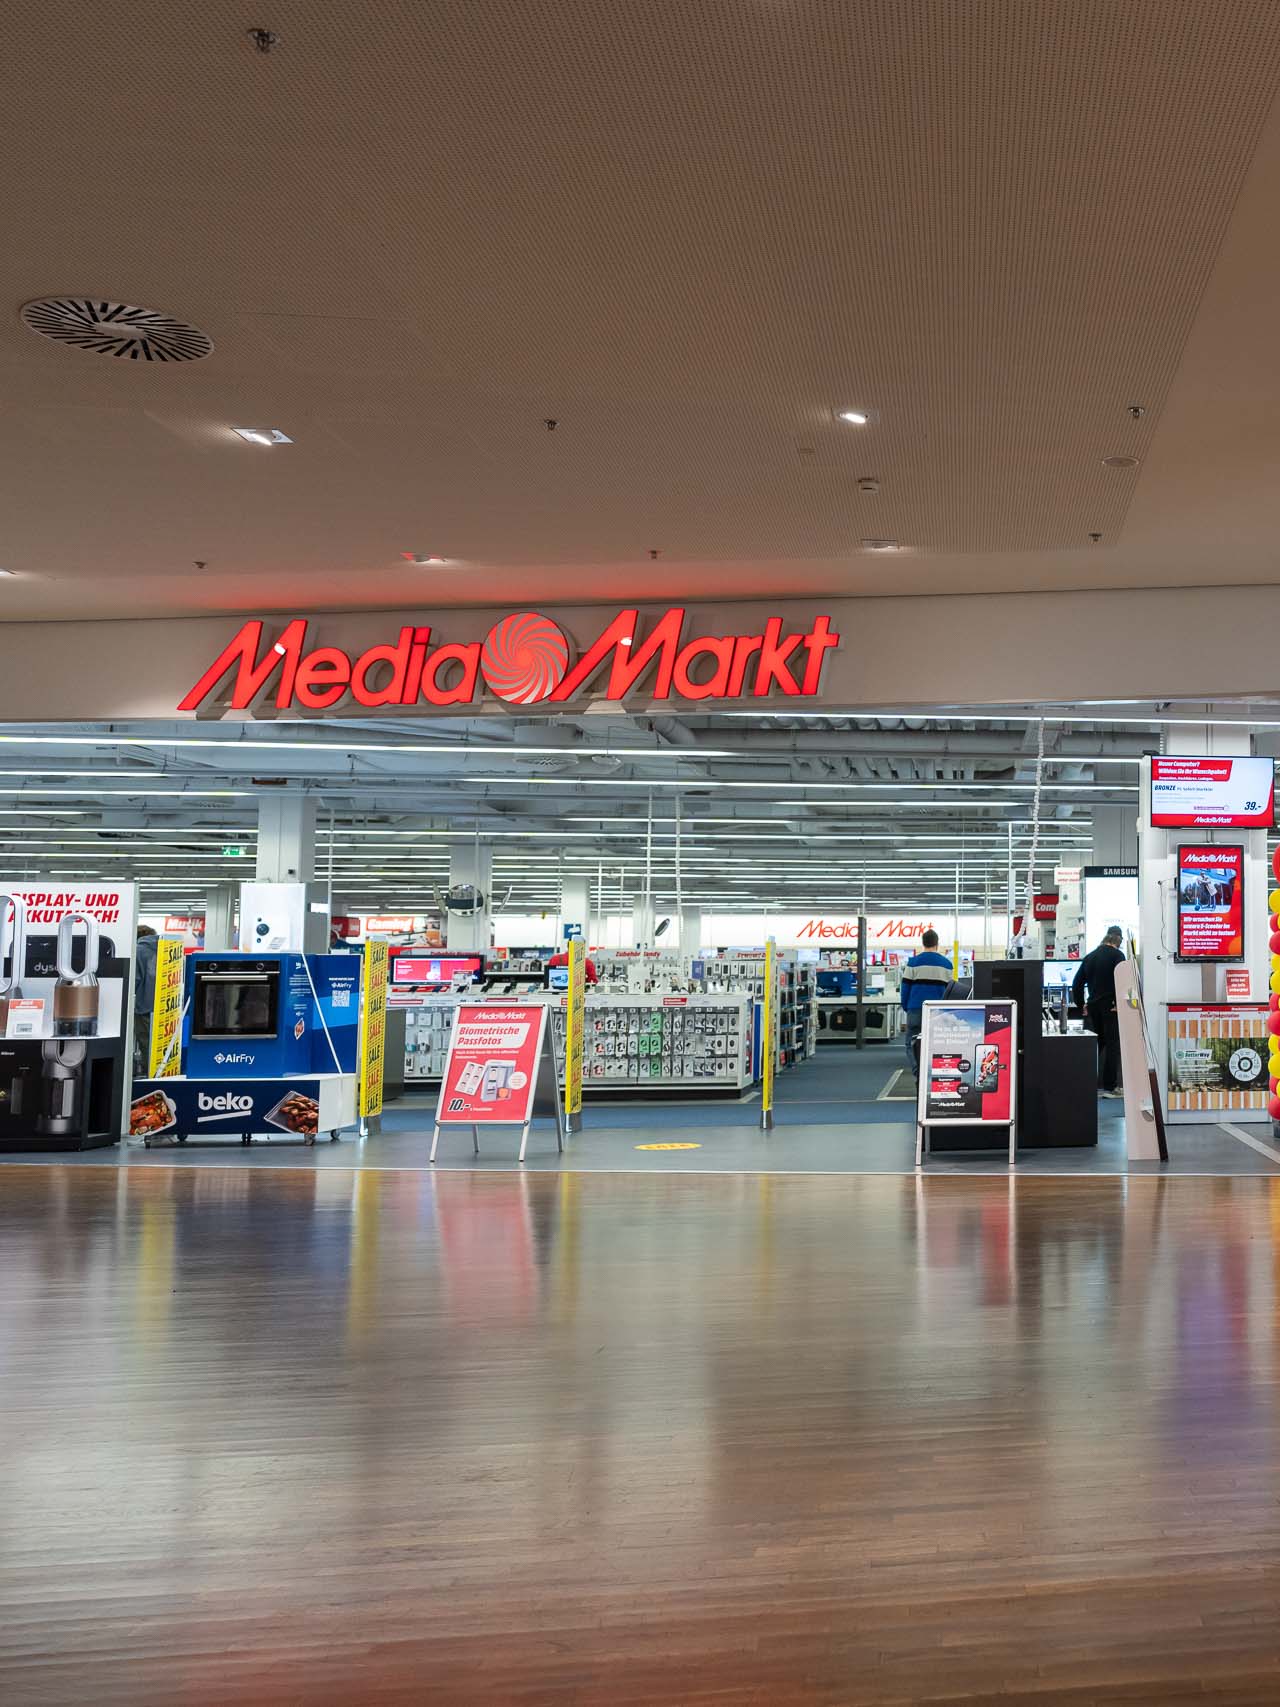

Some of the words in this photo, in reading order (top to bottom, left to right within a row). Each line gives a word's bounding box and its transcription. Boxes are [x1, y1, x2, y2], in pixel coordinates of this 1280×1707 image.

[177, 618, 484, 710] Media
[548, 607, 840, 701] Markt
[1244, 801, 1261, 811] 39.-
[85, 893, 119, 907] UND
[796, 920, 860, 938] Media
[876, 919, 935, 938] Markt
[168, 944, 183, 963] SALE
[372, 946, 384, 964] SALE
[167, 970, 182, 988] SALE
[371, 971, 384, 989] SALE
[165, 994, 181, 1013] SALE
[370, 996, 382, 1015] SALE
[369, 1020, 381, 1040] SALE
[459, 1026, 520, 1035] Biometrische
[457, 1037, 502, 1045] Passfotos
[225, 1053, 255, 1065] AirFry
[368, 1044, 381, 1064] SALE
[367, 1069, 380, 1088] SALE
[198, 1092, 254, 1111] beko
[367, 1093, 379, 1113] SALE
[448, 1098, 471, 1112] 10.-
